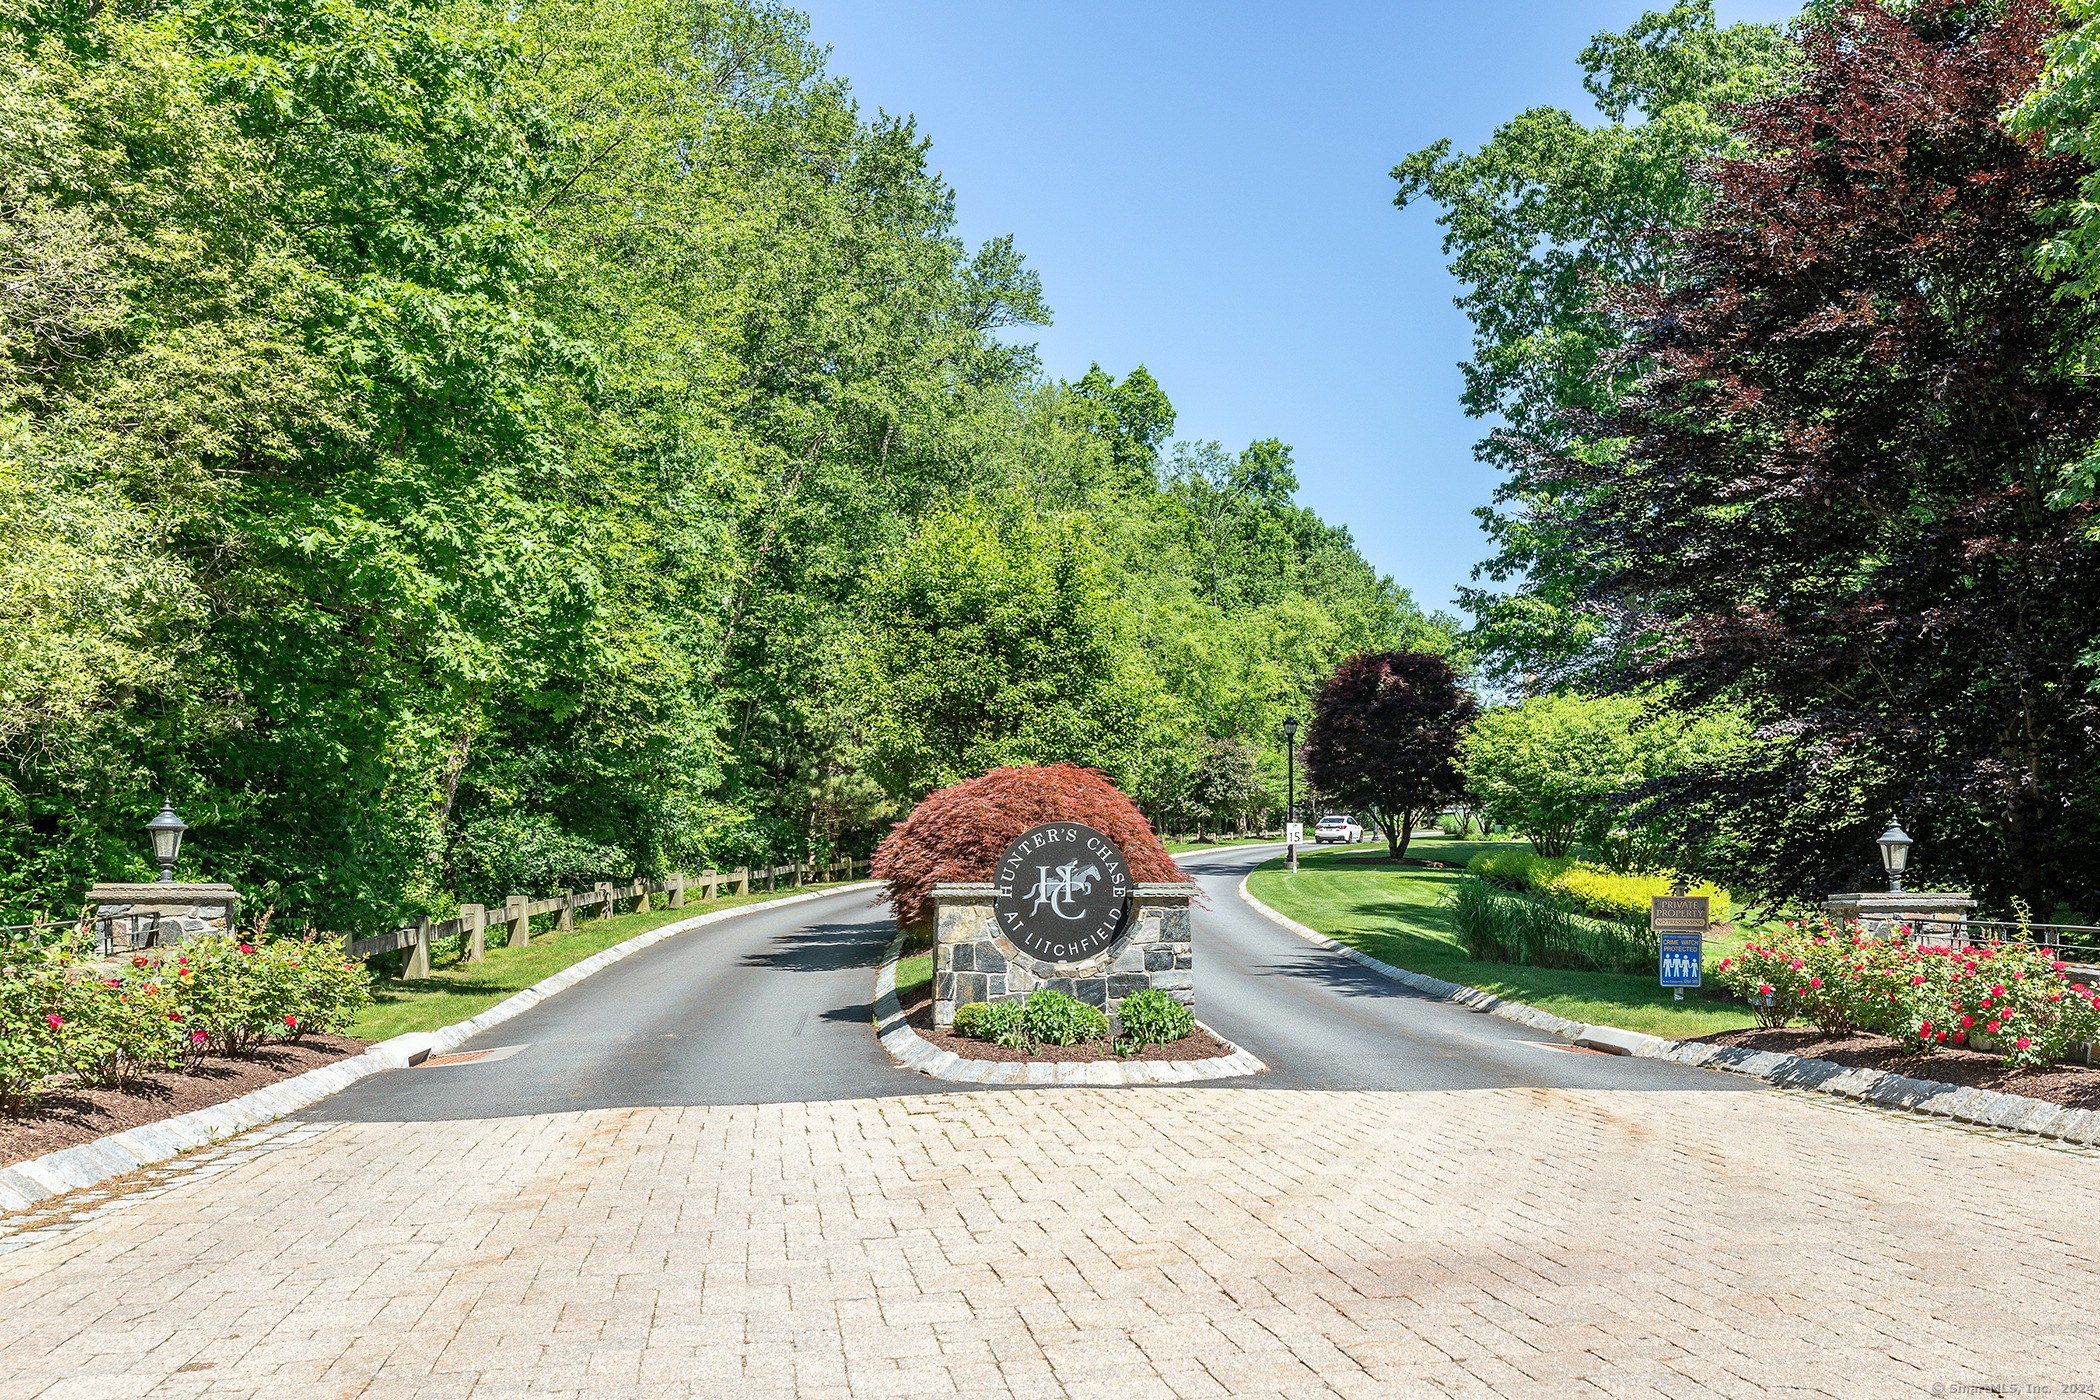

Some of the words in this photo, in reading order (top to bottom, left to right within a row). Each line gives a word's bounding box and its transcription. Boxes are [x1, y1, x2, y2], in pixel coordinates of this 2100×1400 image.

[1290, 832, 1300, 842] 15
[1087, 837, 1126, 898] CHASE
[1661, 901, 1698, 909] PRIVATE
[1656, 910, 1704, 918] PROPERTY
[1004, 911, 1024, 931] AT
[1024, 908, 1121, 956] LITCHFIELD
